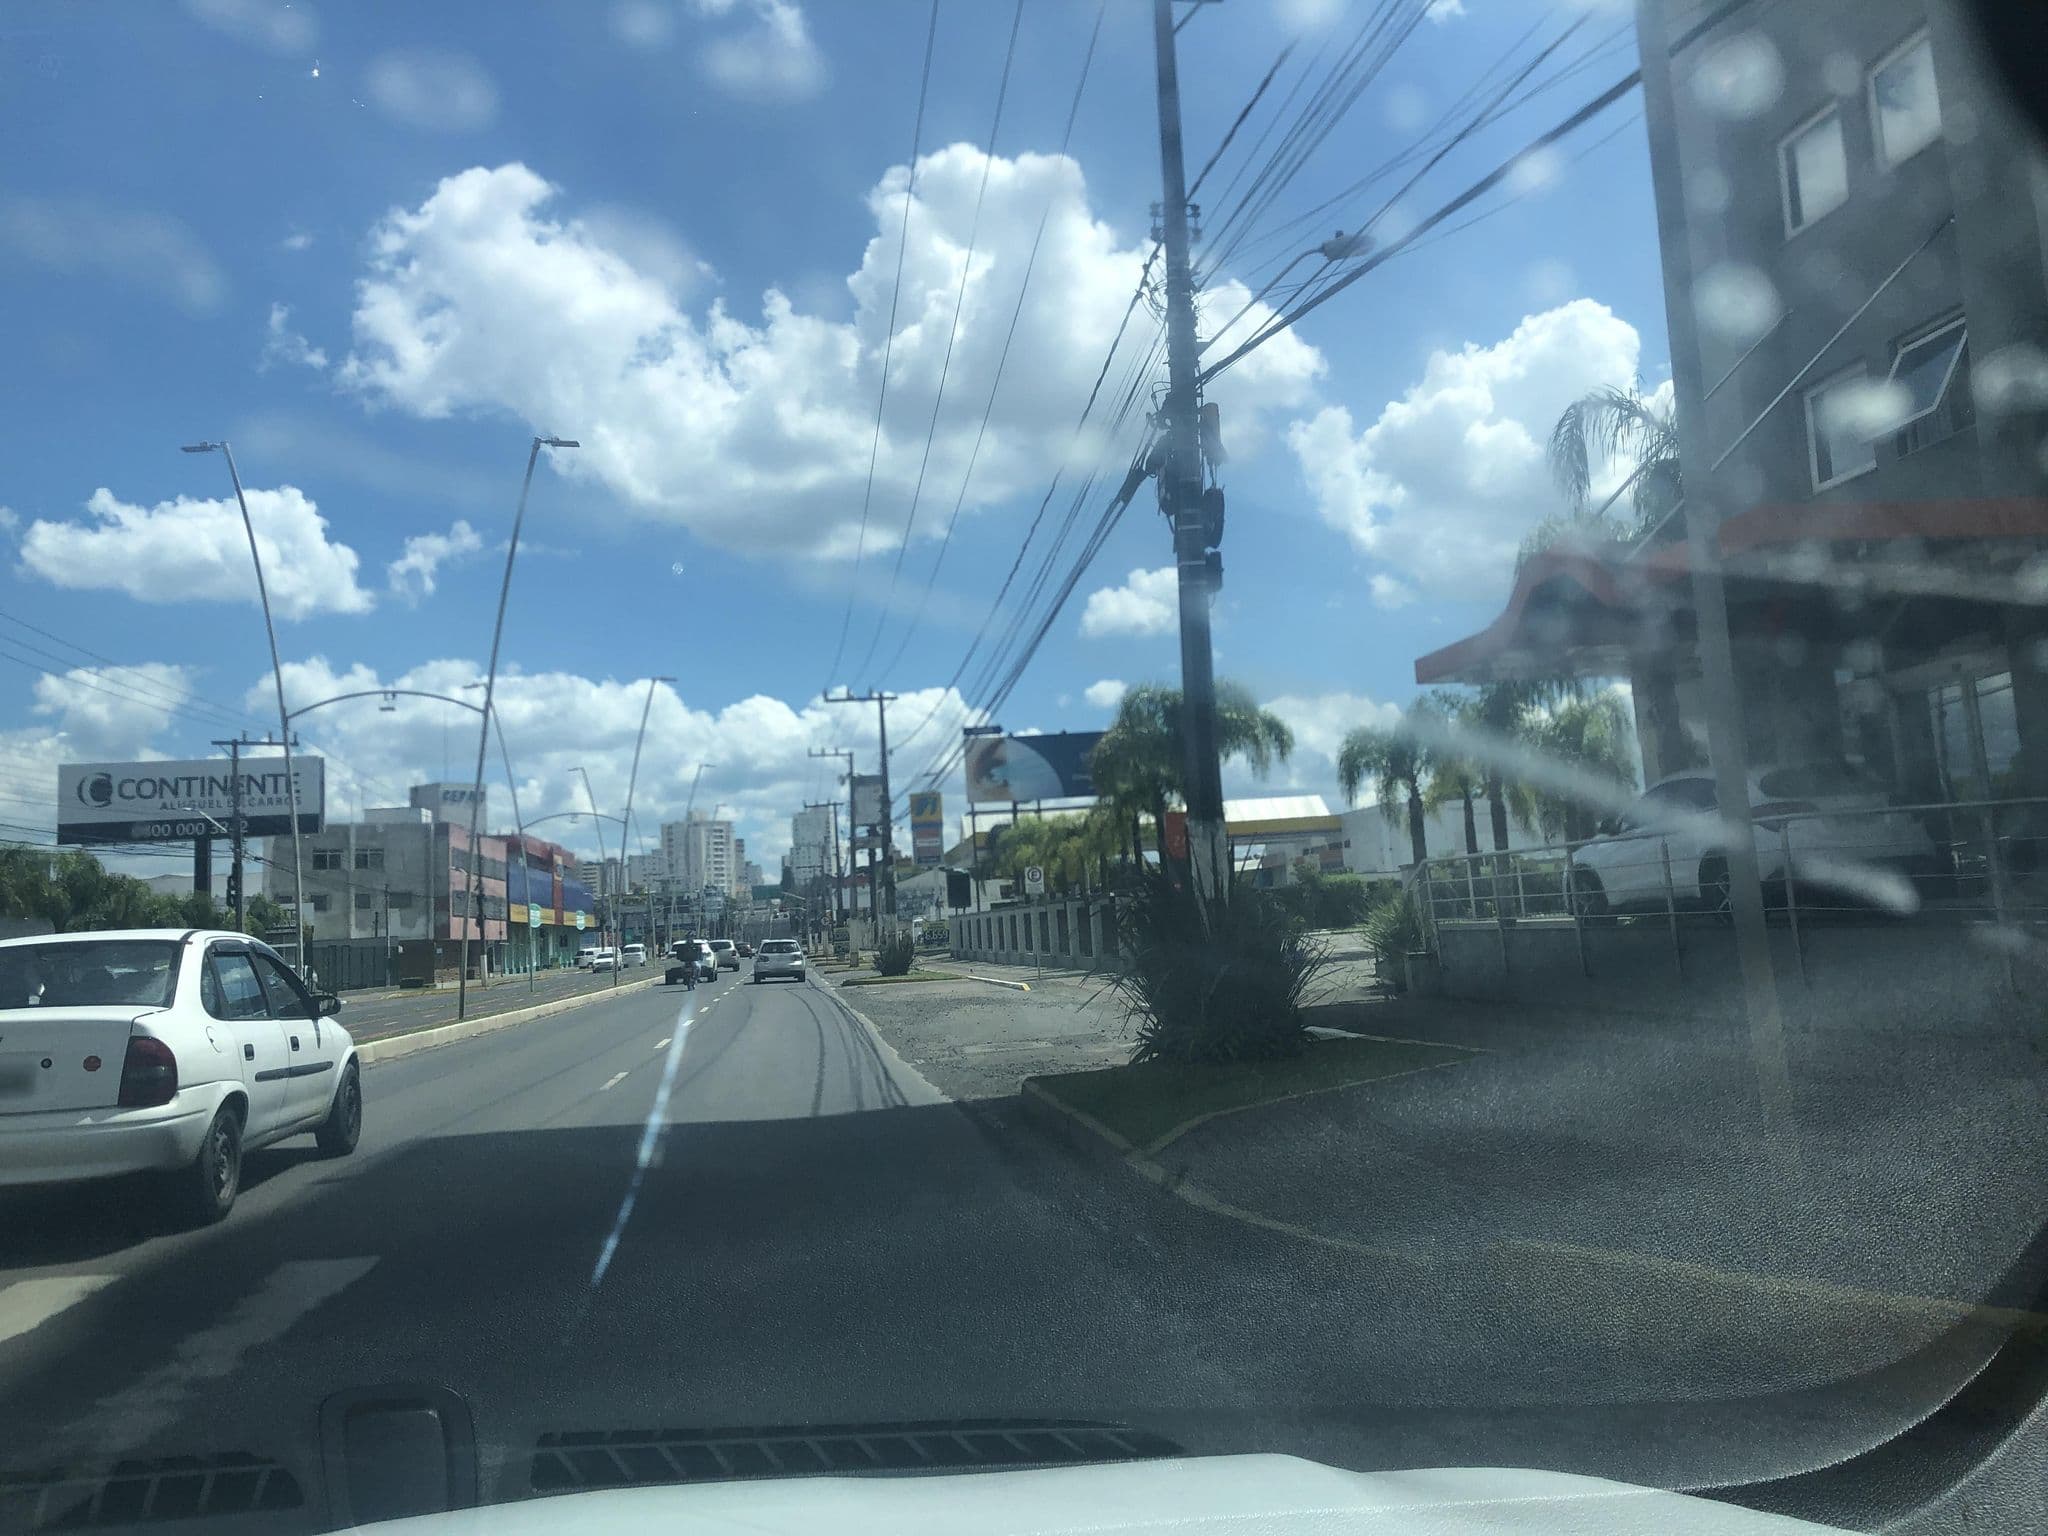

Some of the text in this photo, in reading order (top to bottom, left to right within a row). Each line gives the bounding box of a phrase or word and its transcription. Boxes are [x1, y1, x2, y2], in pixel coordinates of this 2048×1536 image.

[118, 773, 300, 800] CONTINENTE
[175, 822, 205, 837] 000
[209, 820, 248, 835] 322
